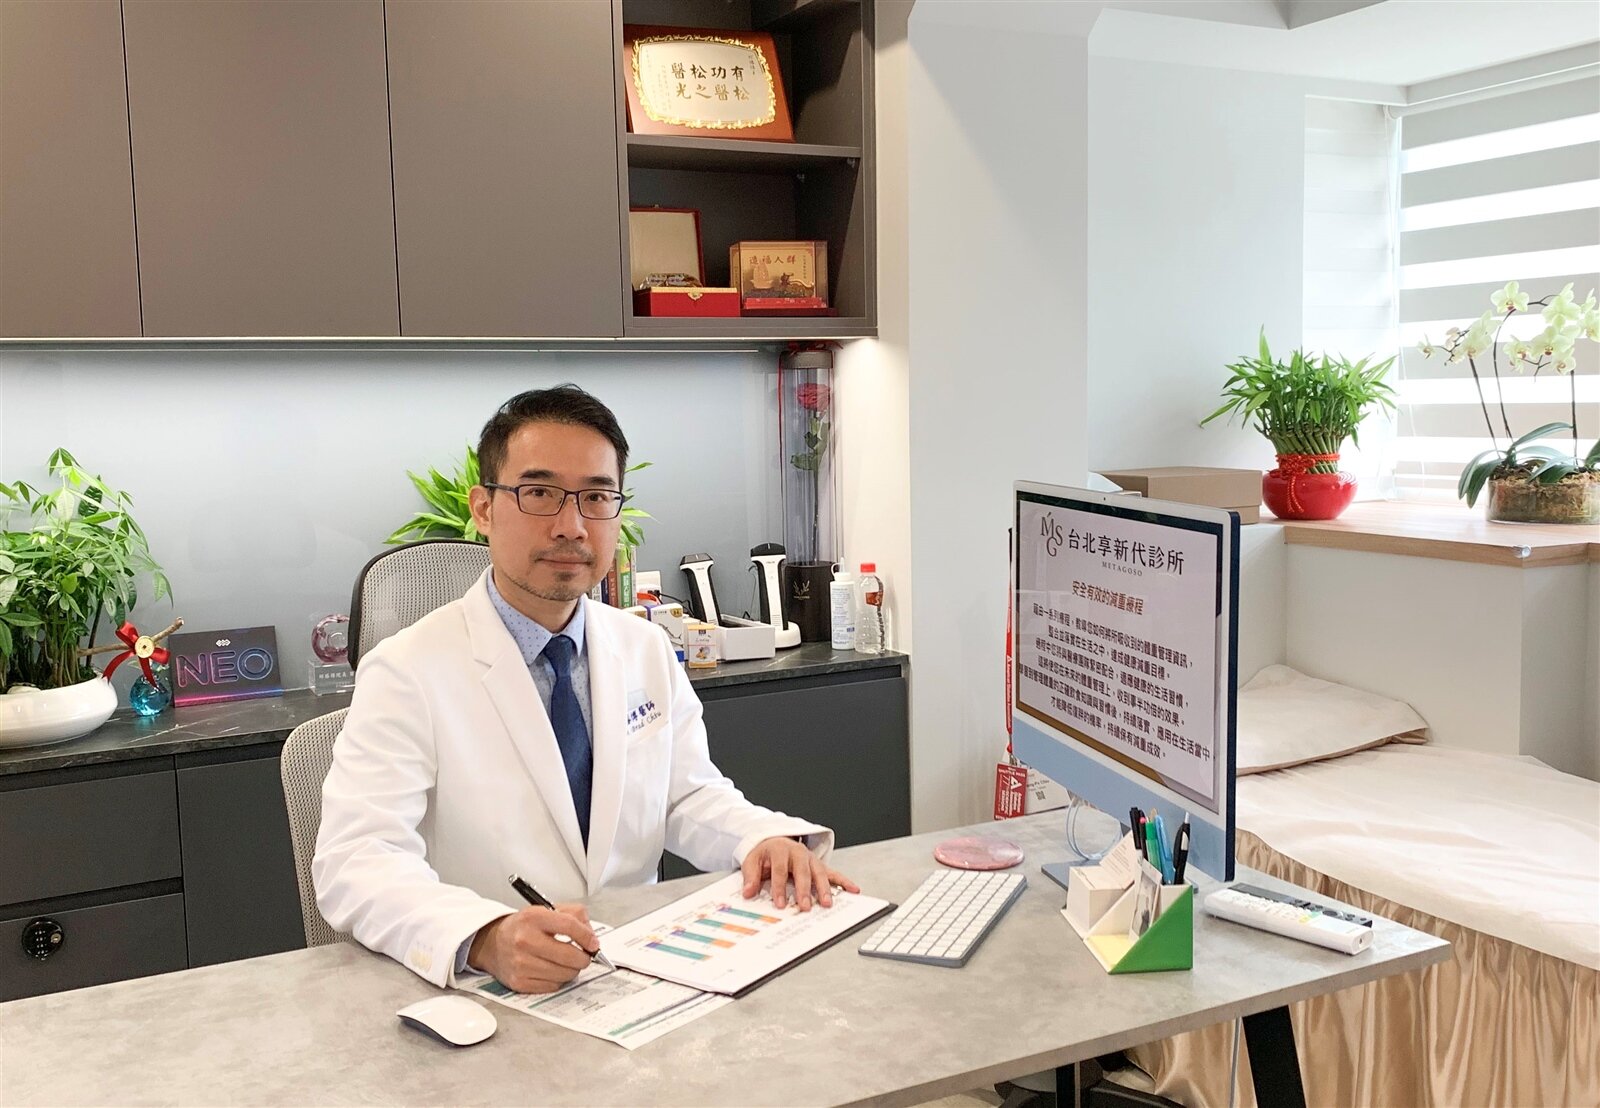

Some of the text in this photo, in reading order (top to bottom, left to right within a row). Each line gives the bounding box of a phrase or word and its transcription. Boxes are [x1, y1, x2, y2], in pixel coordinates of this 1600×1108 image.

[1068, 528, 1185, 576] 台北享新代診所
[1102, 560, 1143, 577] METAGOSO
[1072, 580, 1144, 616] 安全有效的減重療程
[176, 647, 273, 688] NEO
